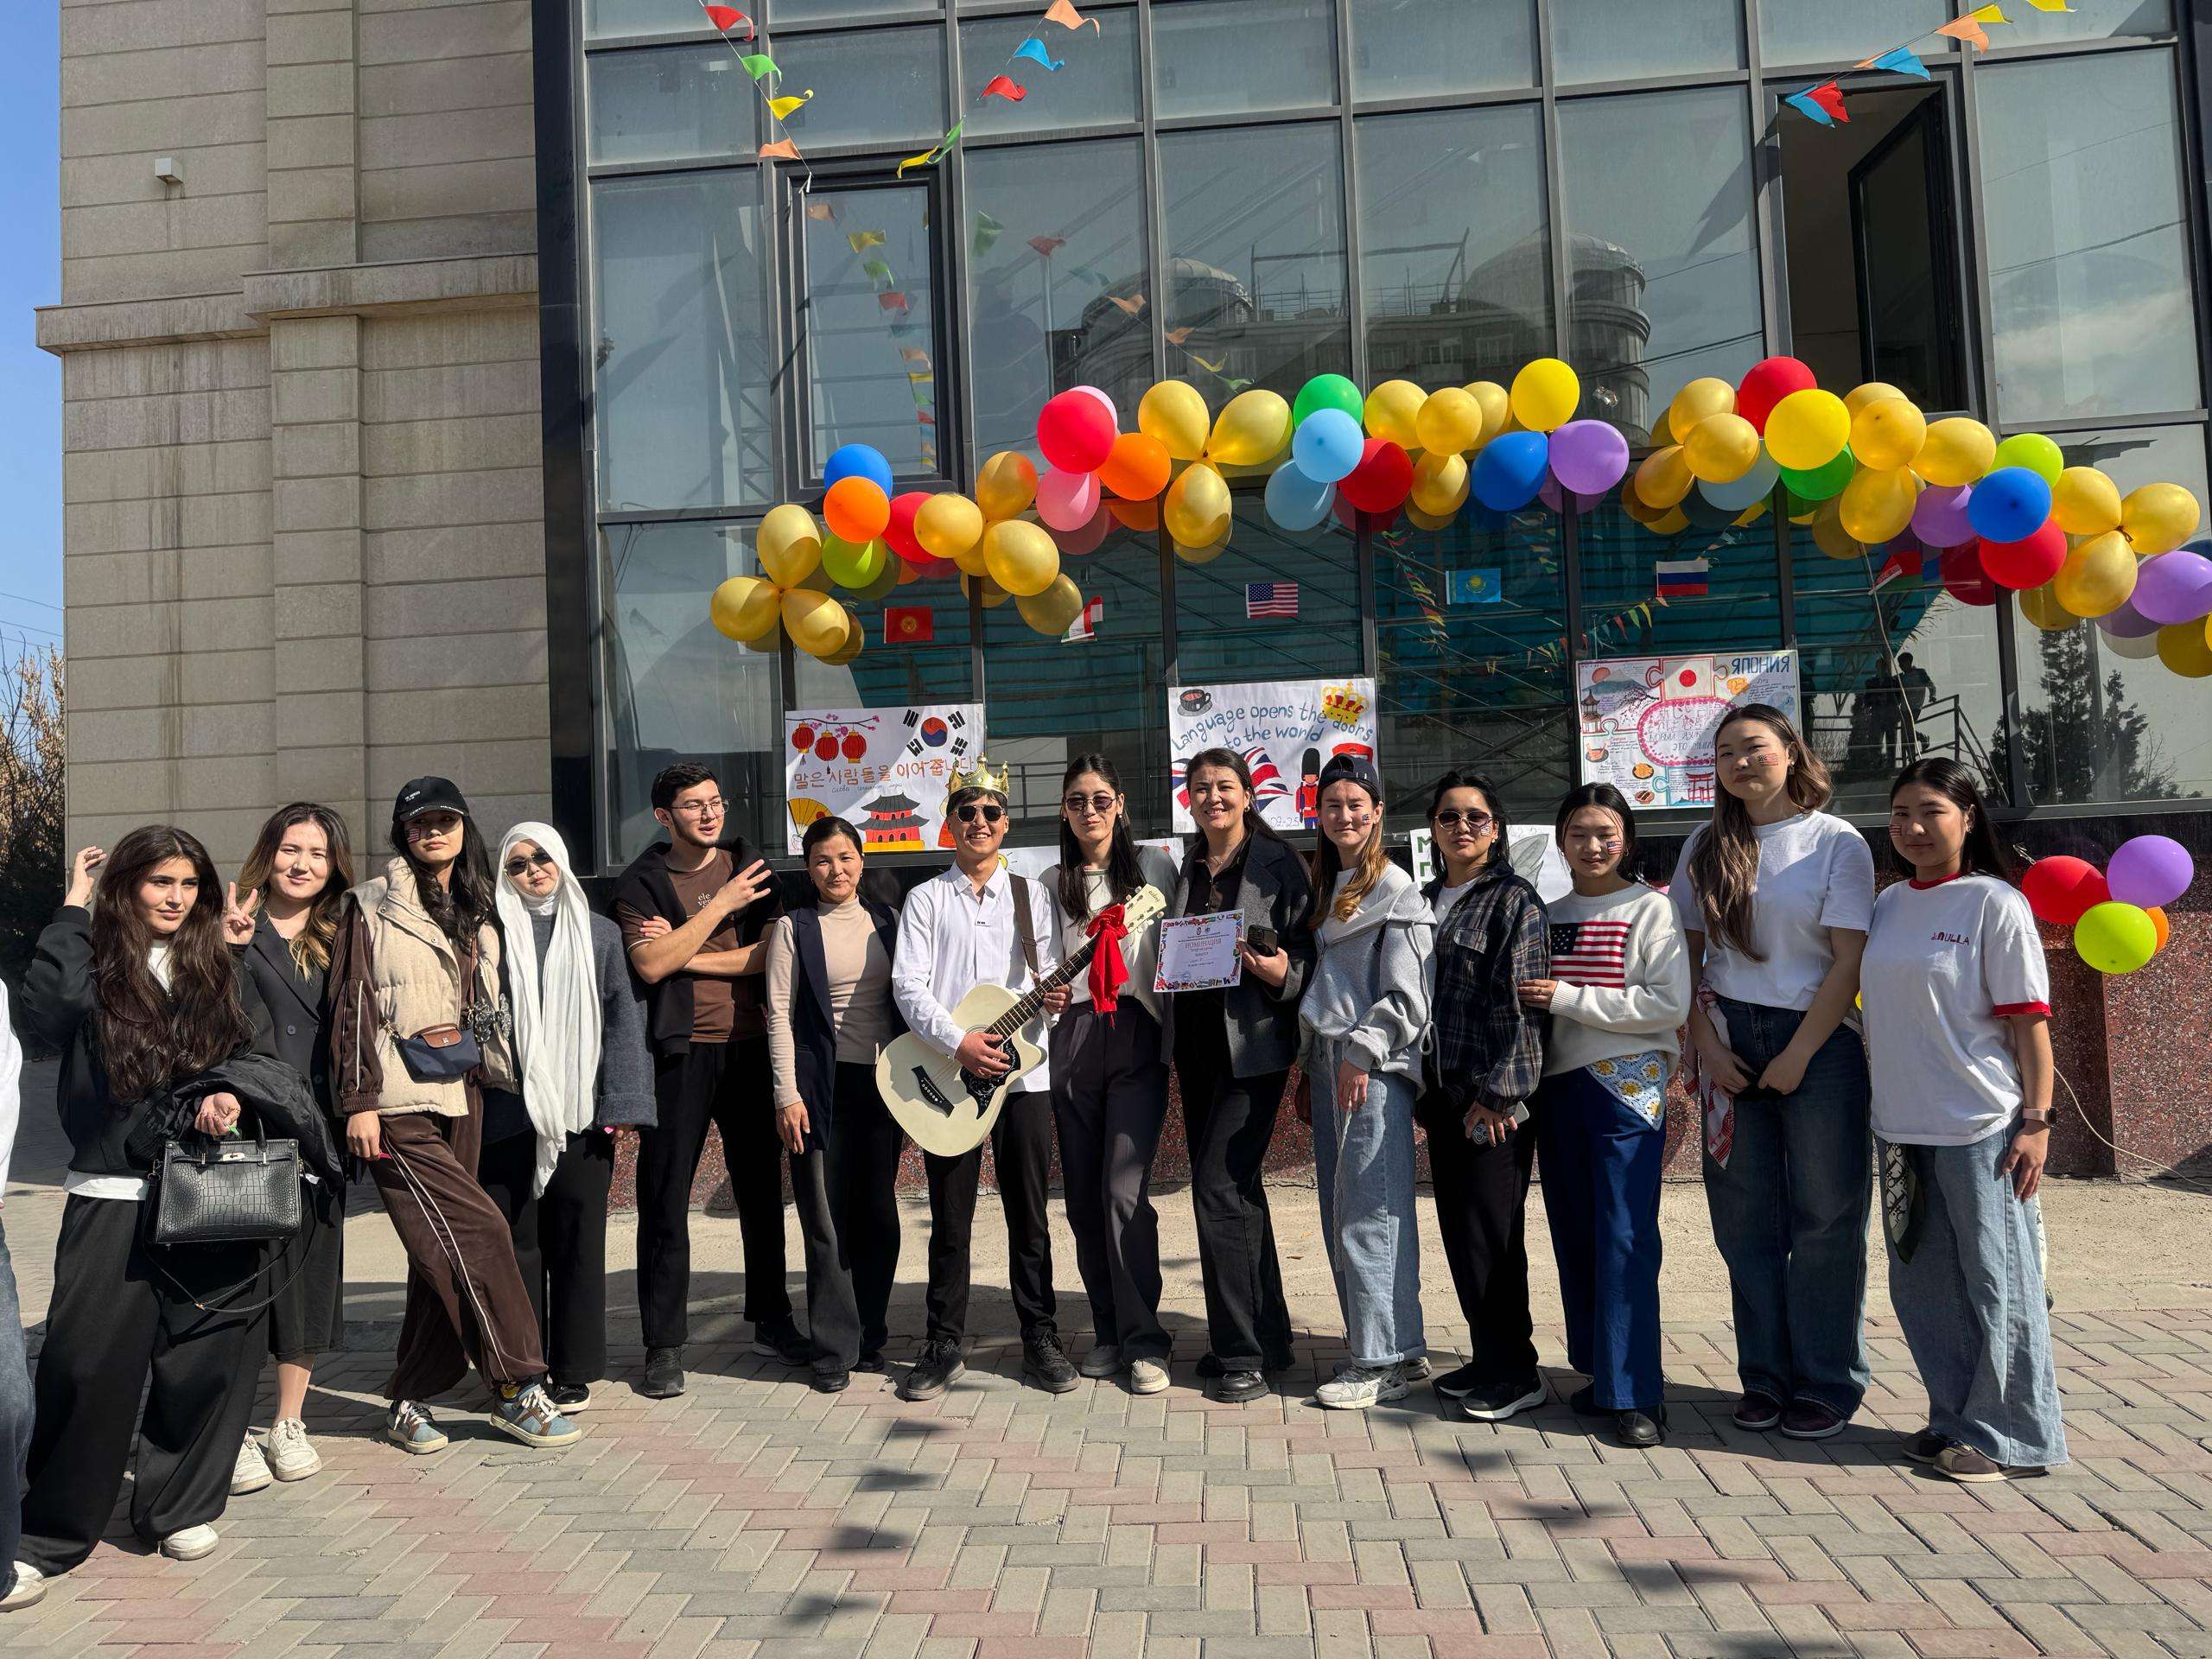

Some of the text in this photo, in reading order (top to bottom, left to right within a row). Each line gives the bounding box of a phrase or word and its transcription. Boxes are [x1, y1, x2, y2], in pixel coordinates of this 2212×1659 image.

[1731, 655, 1790, 674] ЯПОНИЯ
[1172, 702, 1373, 750] Language opens the doors
[1224, 725, 1325, 749] to the world
